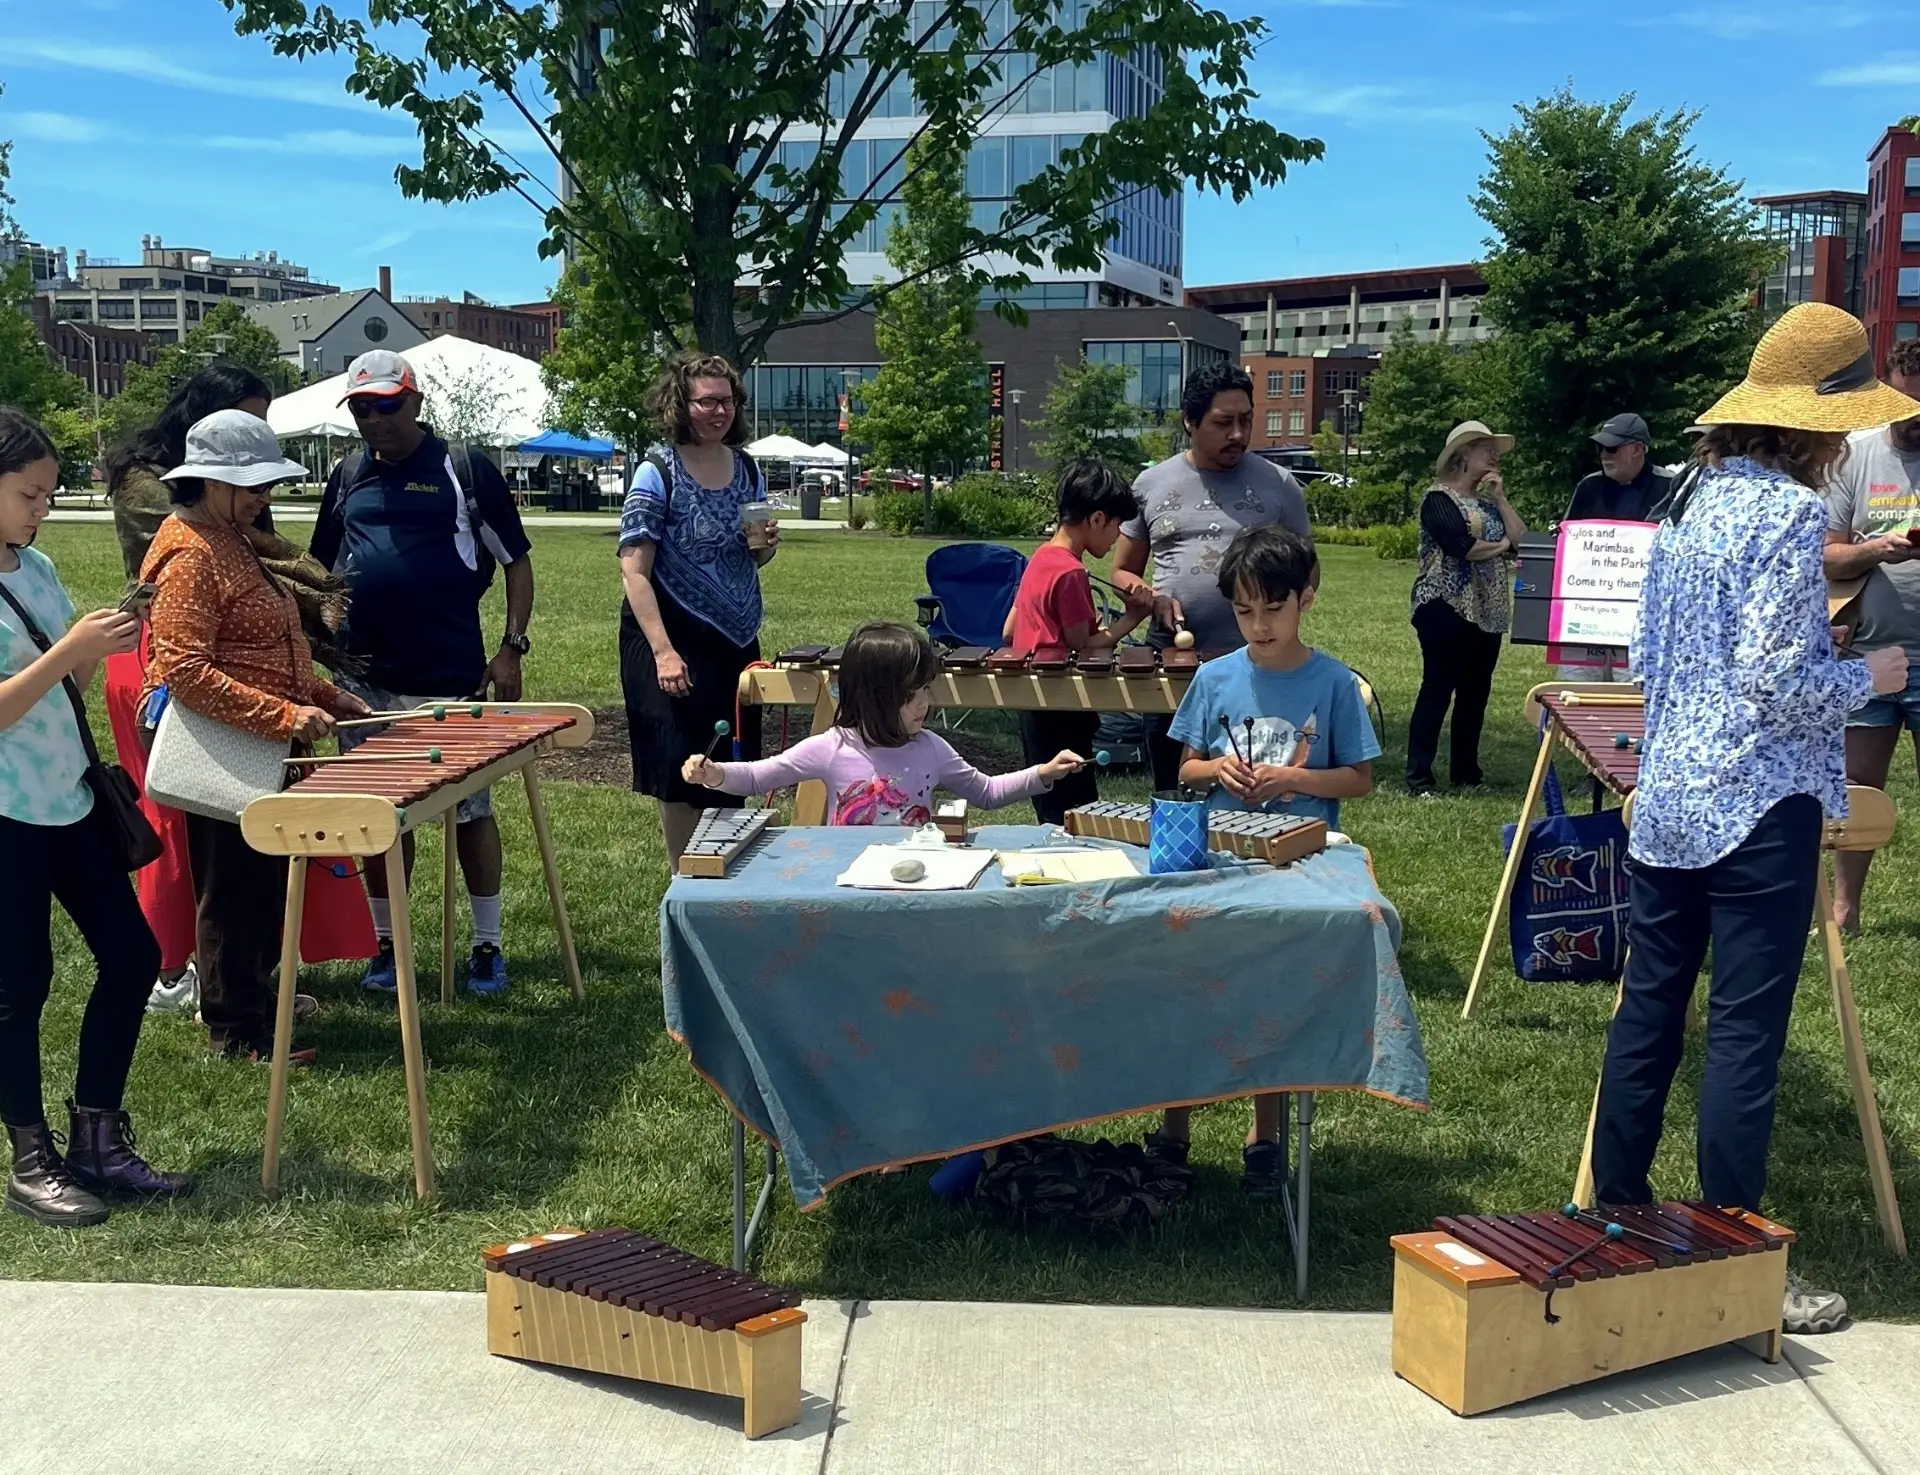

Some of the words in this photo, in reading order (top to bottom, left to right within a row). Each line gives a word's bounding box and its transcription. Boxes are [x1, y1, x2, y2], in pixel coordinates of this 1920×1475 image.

[991, 369, 1001, 408] HALL
[1596, 527, 1616, 538] and
[1583, 540, 1635, 554] Marimbas
[1591, 556, 1601, 566] in
[1603, 556, 1619, 568] the
[1620, 557, 1647, 569] Park
[1567, 574, 1596, 587] Come
[1599, 577, 1614, 590] try
[1616, 577, 1641, 589] them
[1574, 603, 1596, 612] Thank
[1597, 607, 1610, 615] you
